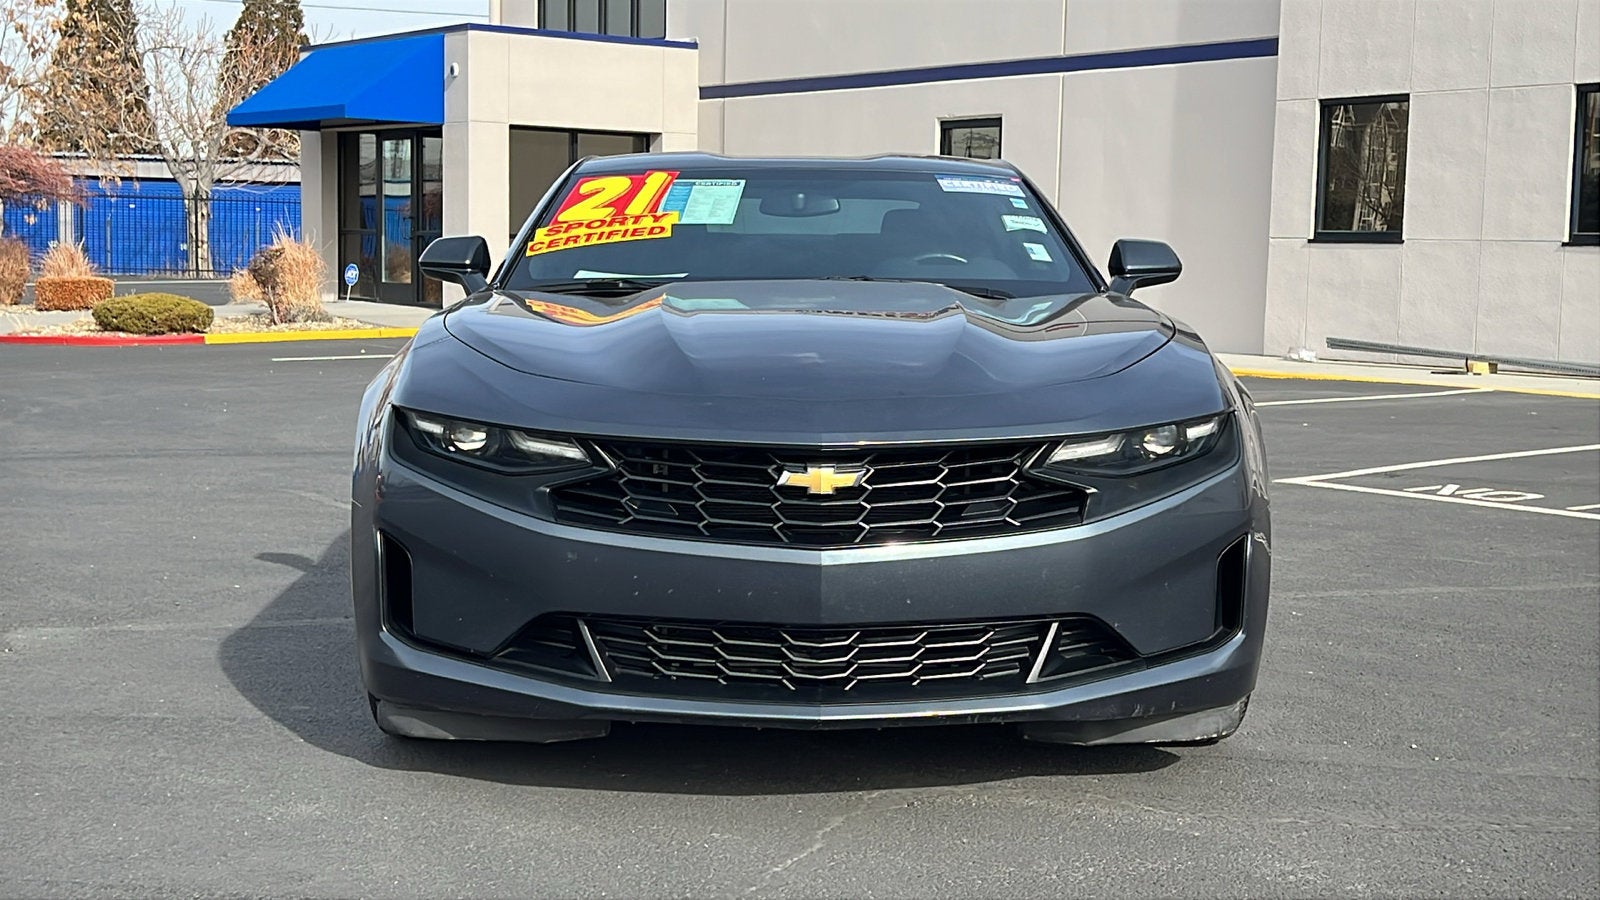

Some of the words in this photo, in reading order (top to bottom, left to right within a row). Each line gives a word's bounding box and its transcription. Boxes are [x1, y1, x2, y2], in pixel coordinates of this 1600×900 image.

[557, 171, 672, 222] 21
[528, 225, 667, 253] CERTIFIED
[544, 213, 671, 237] SPORTY
